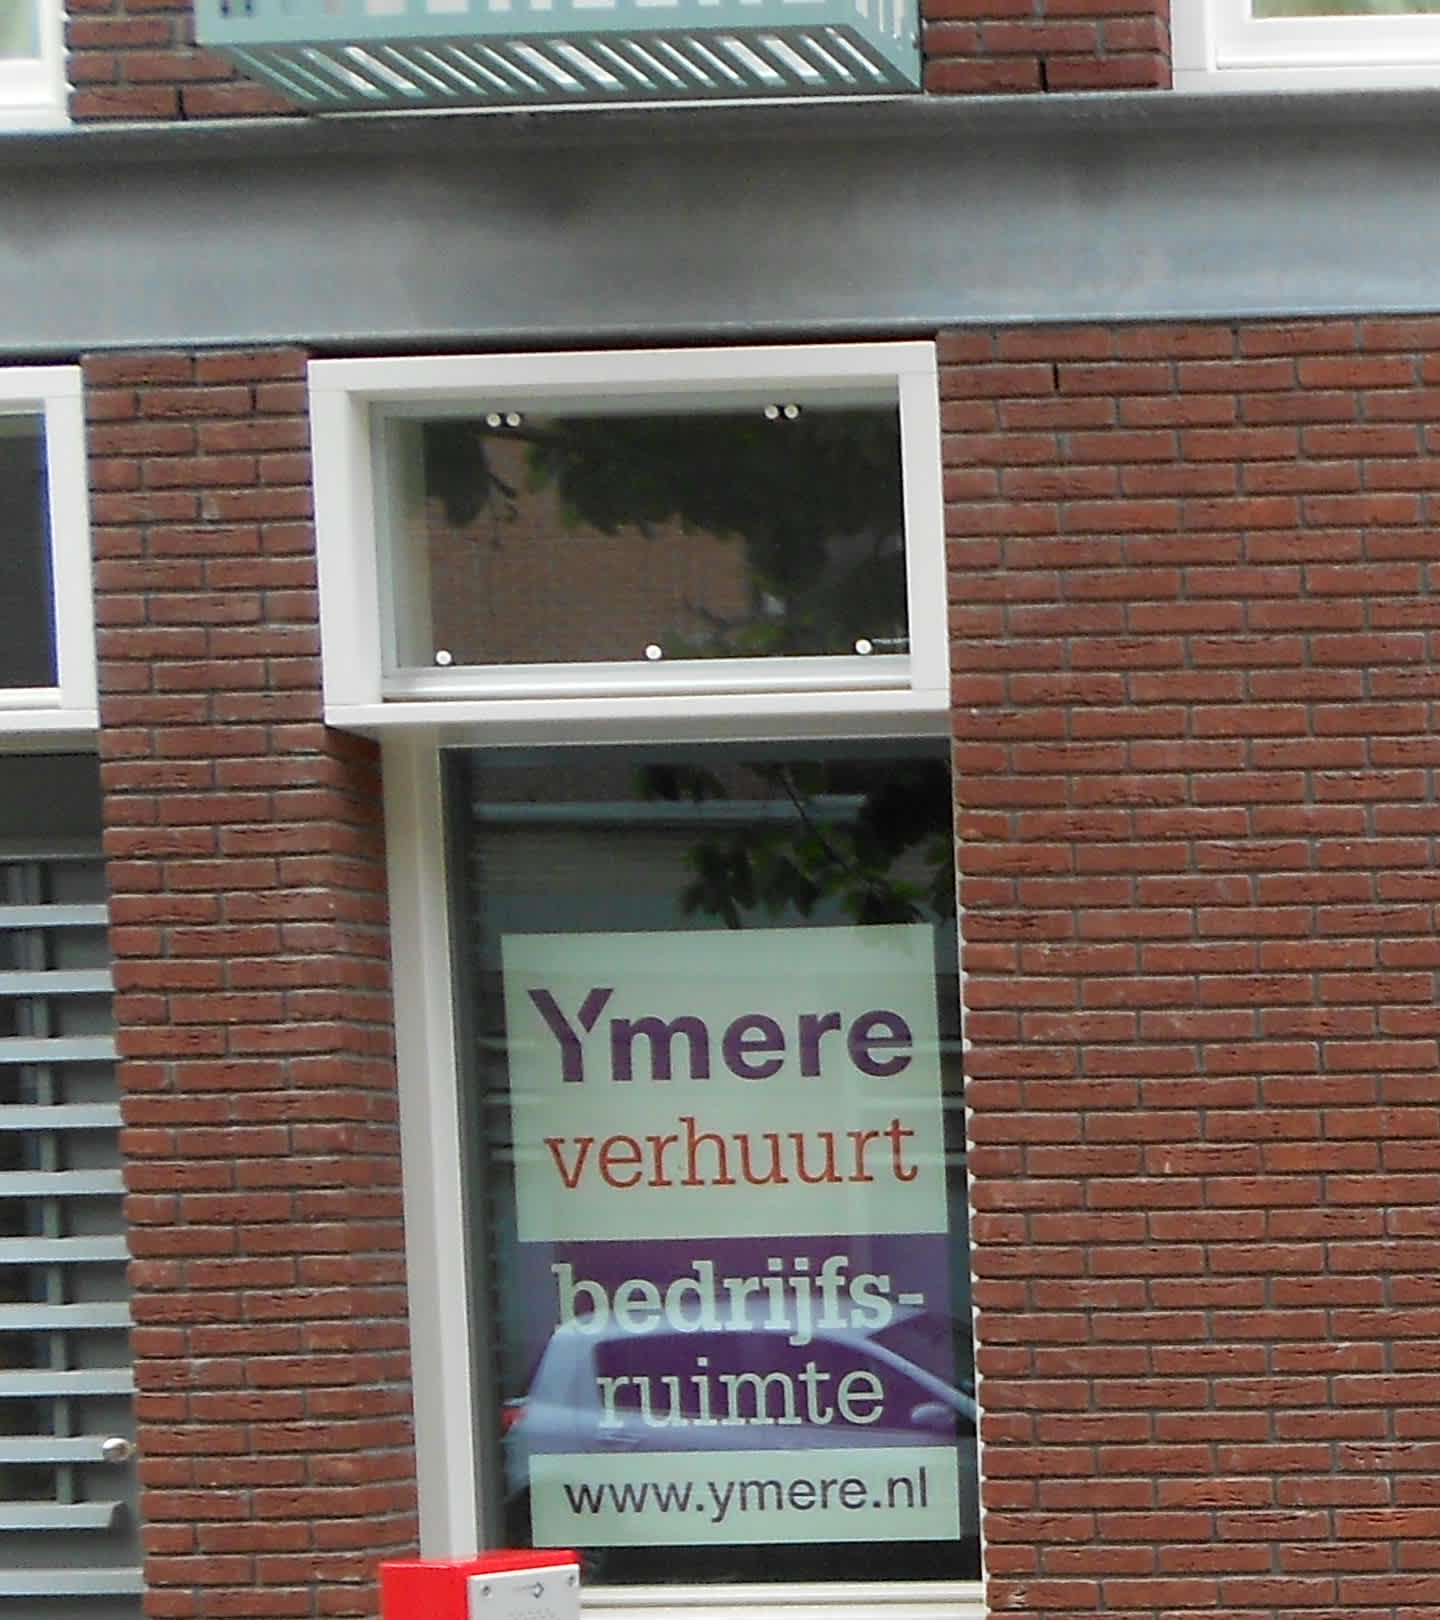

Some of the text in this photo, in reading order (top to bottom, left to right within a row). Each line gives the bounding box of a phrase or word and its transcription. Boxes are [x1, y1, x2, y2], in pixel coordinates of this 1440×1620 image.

[526, 987, 914, 1083] Ymere
[543, 1116, 919, 1189] verhuurt
[551, 1255, 925, 1345] bedrijfs-
[595, 1356, 886, 1429] ruimte
[564, 1467, 929, 1524] www.ymere.nl
